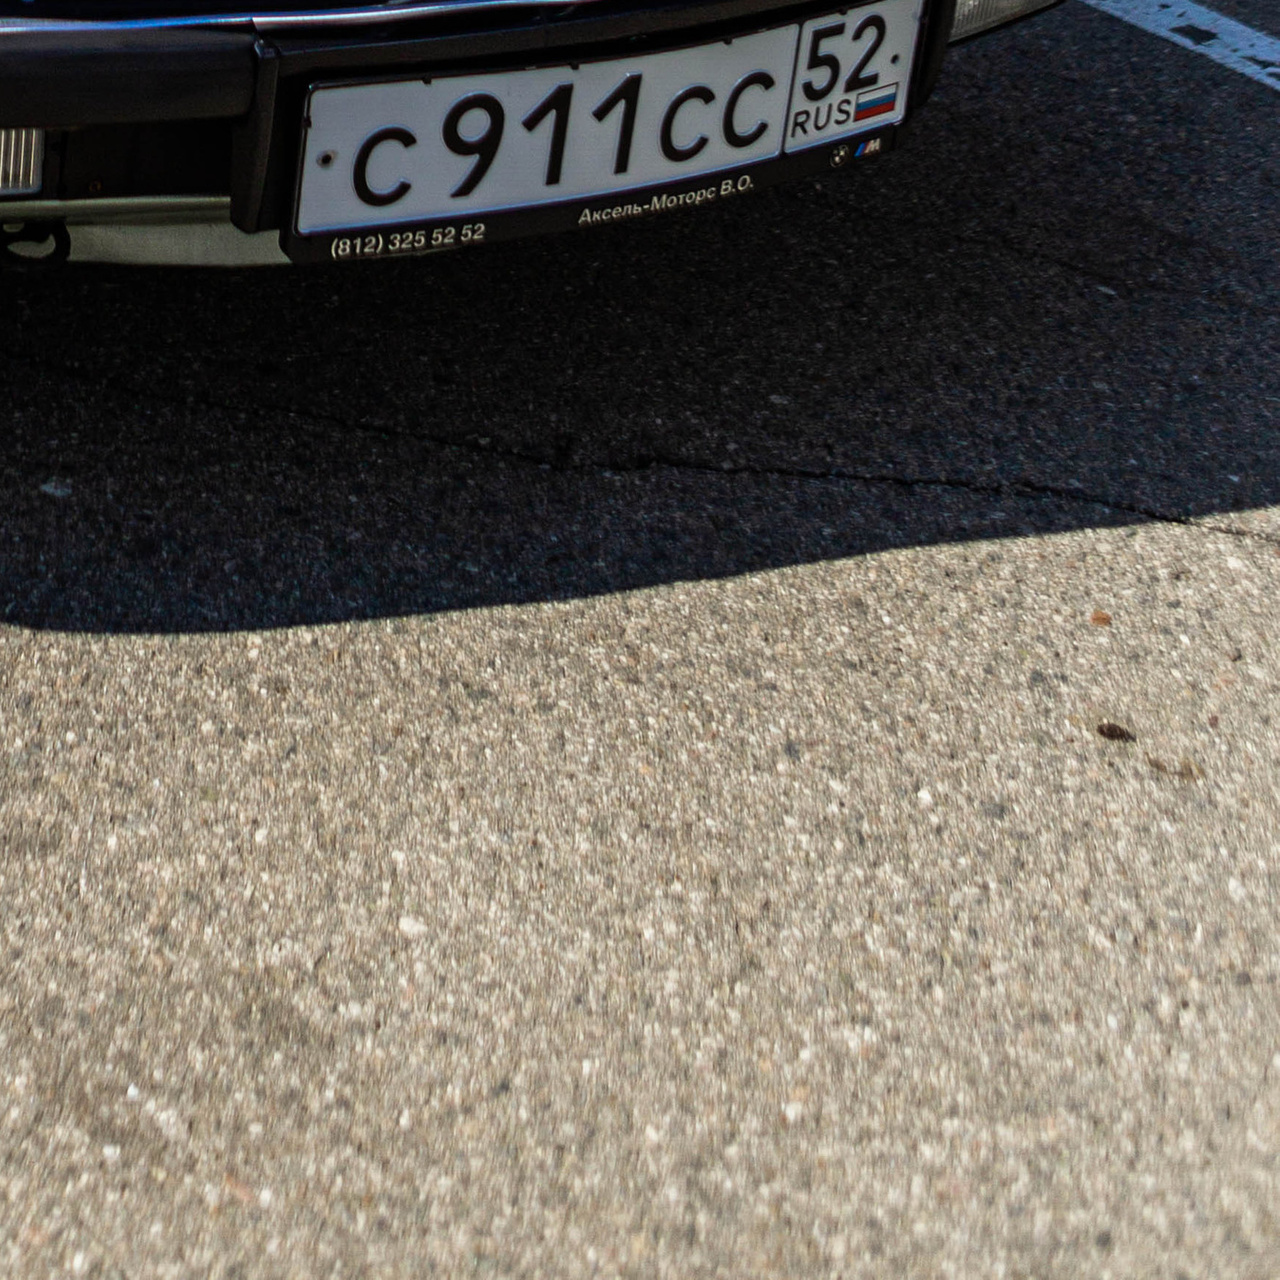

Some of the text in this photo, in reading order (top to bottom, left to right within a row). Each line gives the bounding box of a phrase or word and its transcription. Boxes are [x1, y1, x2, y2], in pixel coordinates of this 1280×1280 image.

[802, 14, 886, 101] 52
[791, 98, 852, 138] RUS
[578, 187, 717, 224] Аксель-Моторс
[331, 223, 486, 260] (812) 325 52 52
